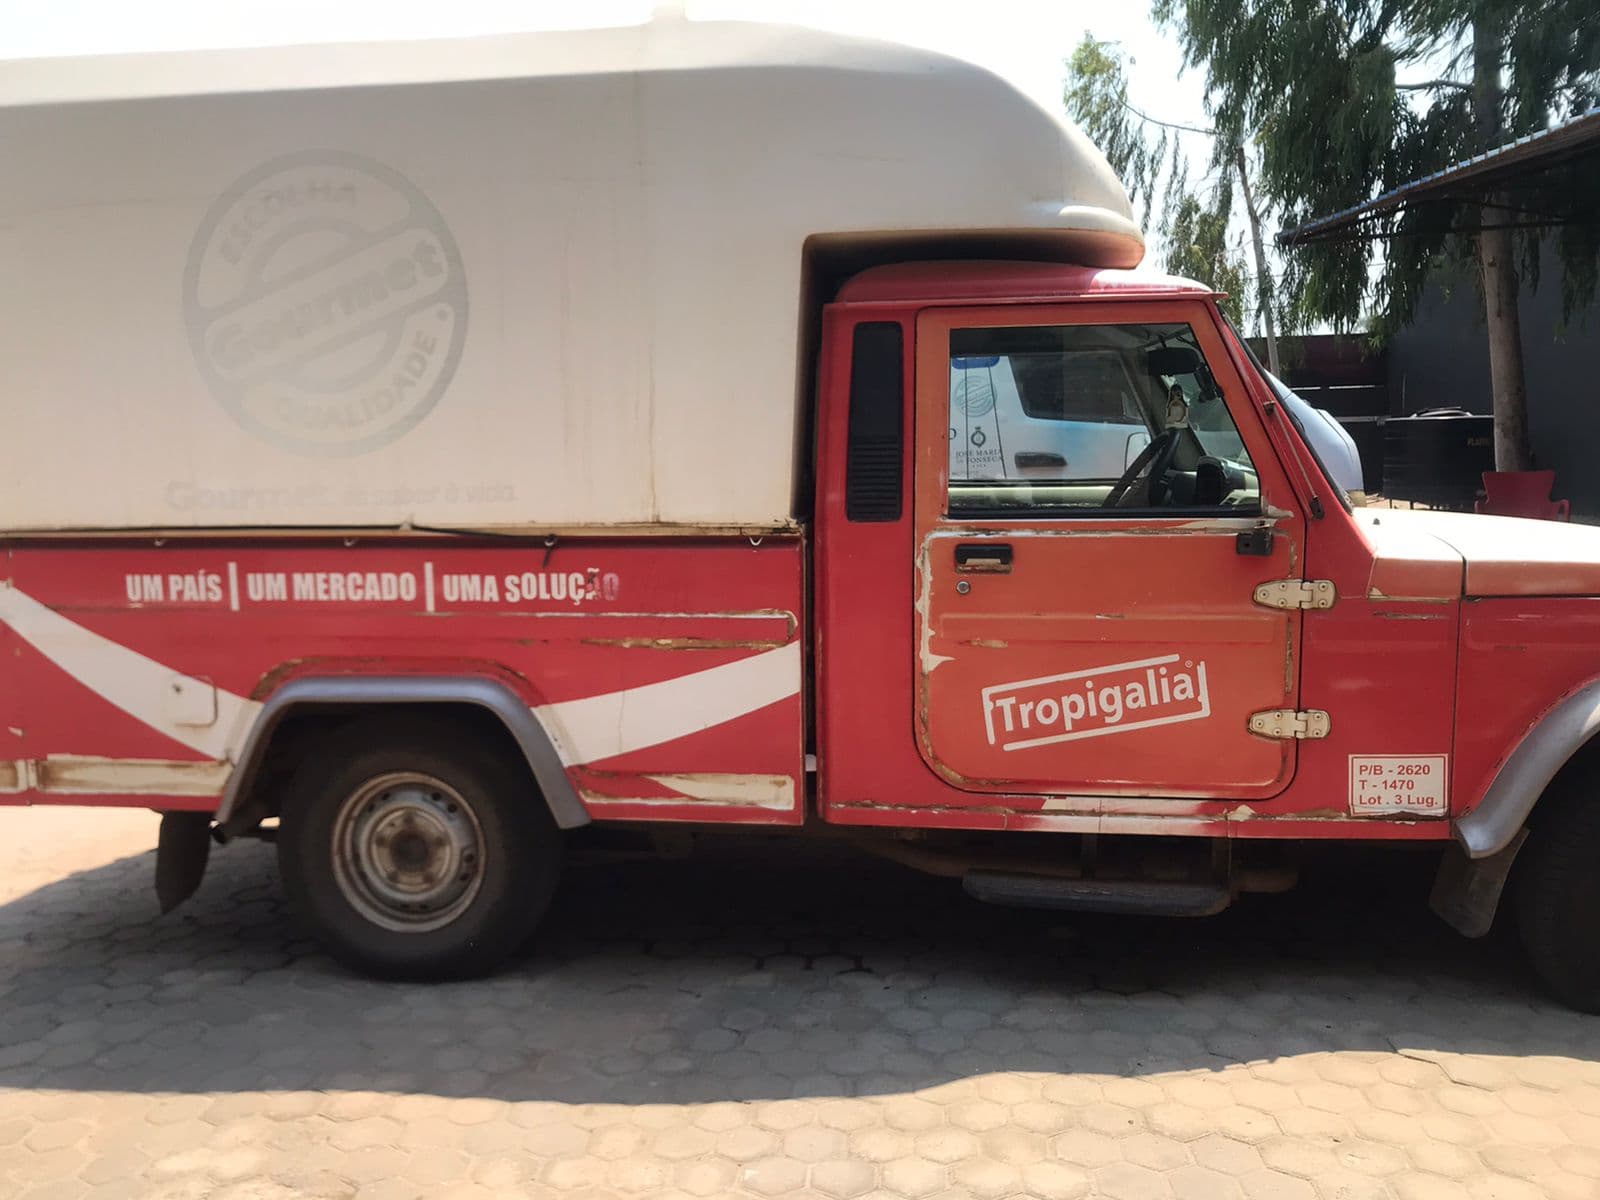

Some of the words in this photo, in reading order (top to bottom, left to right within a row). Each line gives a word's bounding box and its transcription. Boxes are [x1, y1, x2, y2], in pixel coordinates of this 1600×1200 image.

[125, 574, 164, 601] UM
[168, 569, 223, 602] PAÍS
[247, 572, 288, 601] UM
[293, 572, 417, 601] MERCADO
[443, 574, 499, 602] UMA
[1359, 765, 1383, 776] P/B
[1397, 764, 1431, 776] 2620
[1359, 780, 1368, 790] T
[1382, 780, 1415, 790] 1470
[1359, 794, 1382, 805] Lot
[1394, 794, 1403, 805] 3
[1407, 794, 1438, 808] Lug.
